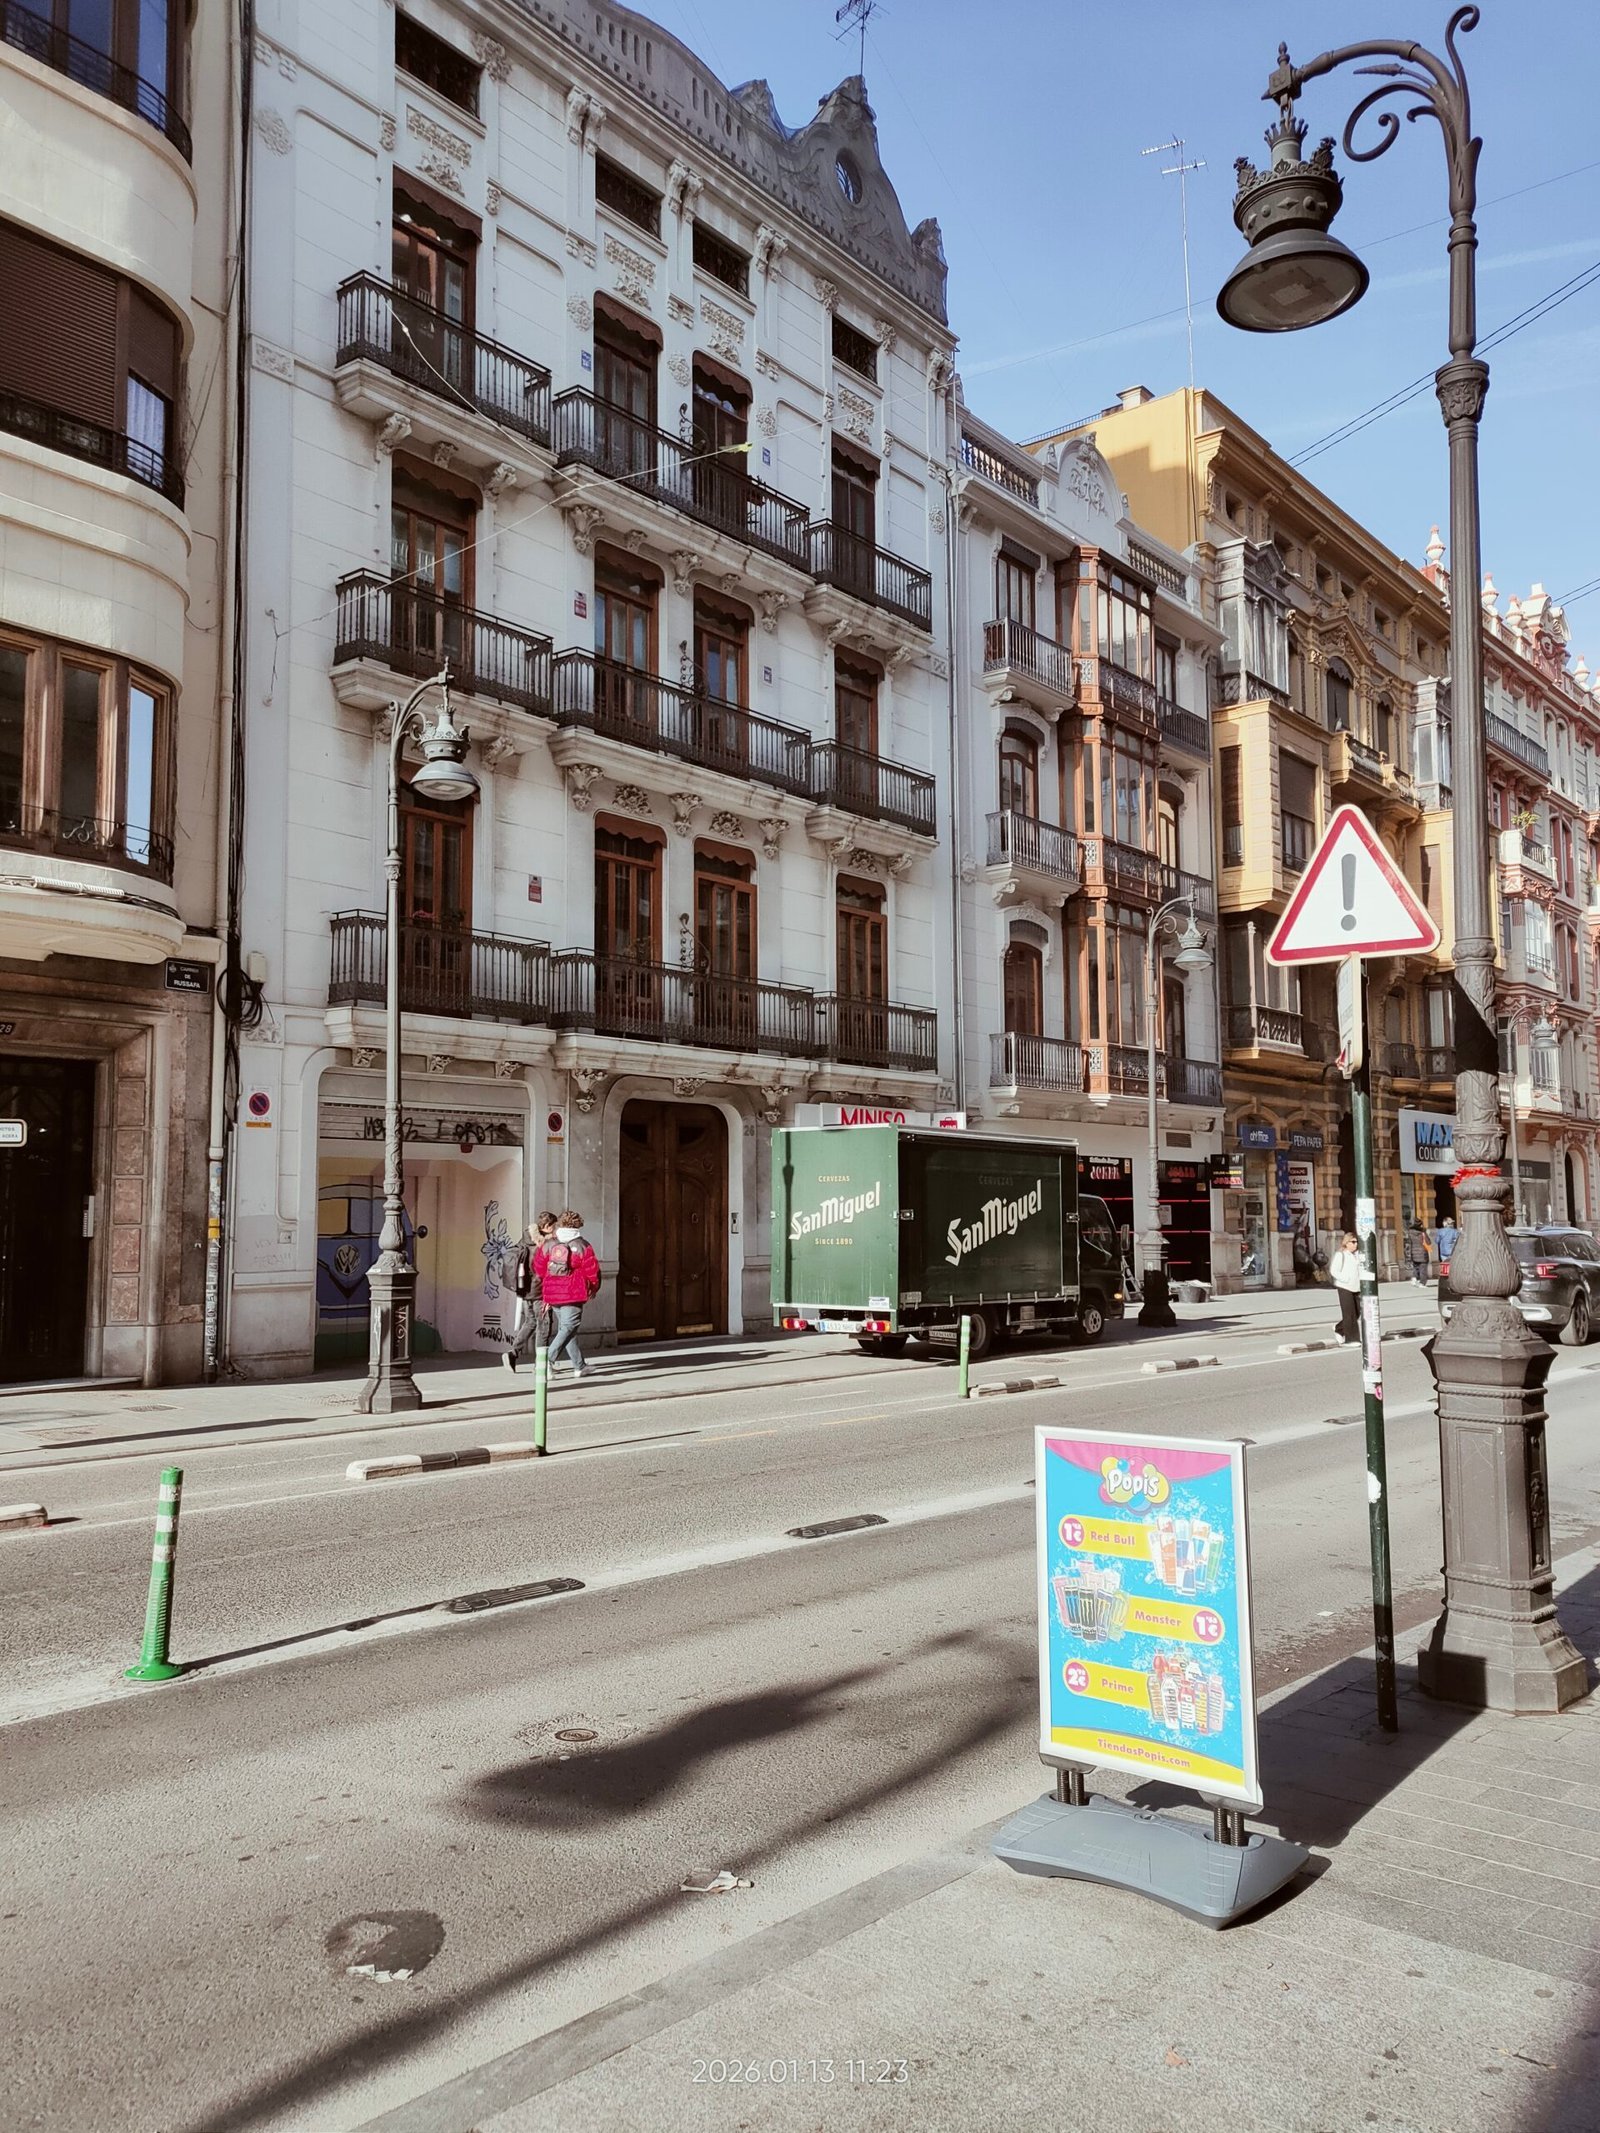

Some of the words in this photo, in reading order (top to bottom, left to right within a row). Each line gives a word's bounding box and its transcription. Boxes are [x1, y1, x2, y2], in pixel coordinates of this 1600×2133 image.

[173, 979, 200, 988] RUSSAFA
[743, 1125, 755, 1136] 26
[1414, 1121, 1453, 1146] MAX
[1307, 1136, 1323, 1148] PAPER
[1107, 1468, 1160, 1497] Popis
[1090, 1531, 1110, 1542] Red
[1114, 1534, 1136, 1546] Bull
[1134, 1610, 1182, 1627] Monster
[1101, 1678, 1134, 1694] Prime
[1097, 1738, 1191, 1768] TiendasPopis.com
